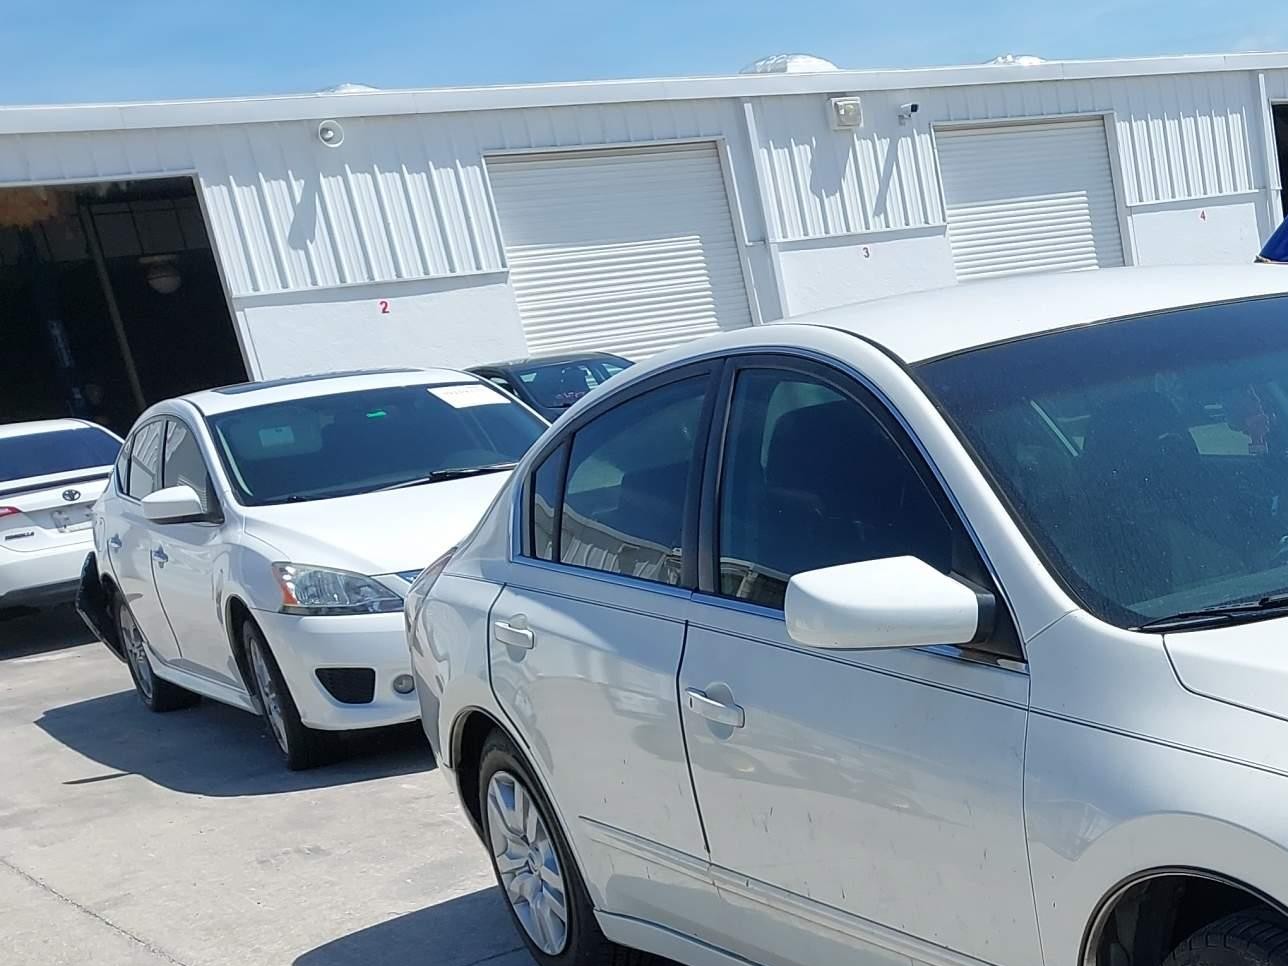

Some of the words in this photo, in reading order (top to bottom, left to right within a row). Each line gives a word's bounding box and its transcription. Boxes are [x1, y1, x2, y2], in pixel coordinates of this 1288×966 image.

[1200, 209, 1206, 221] 4
[862, 246, 870, 258] 3
[379, 300, 390, 314] 2
